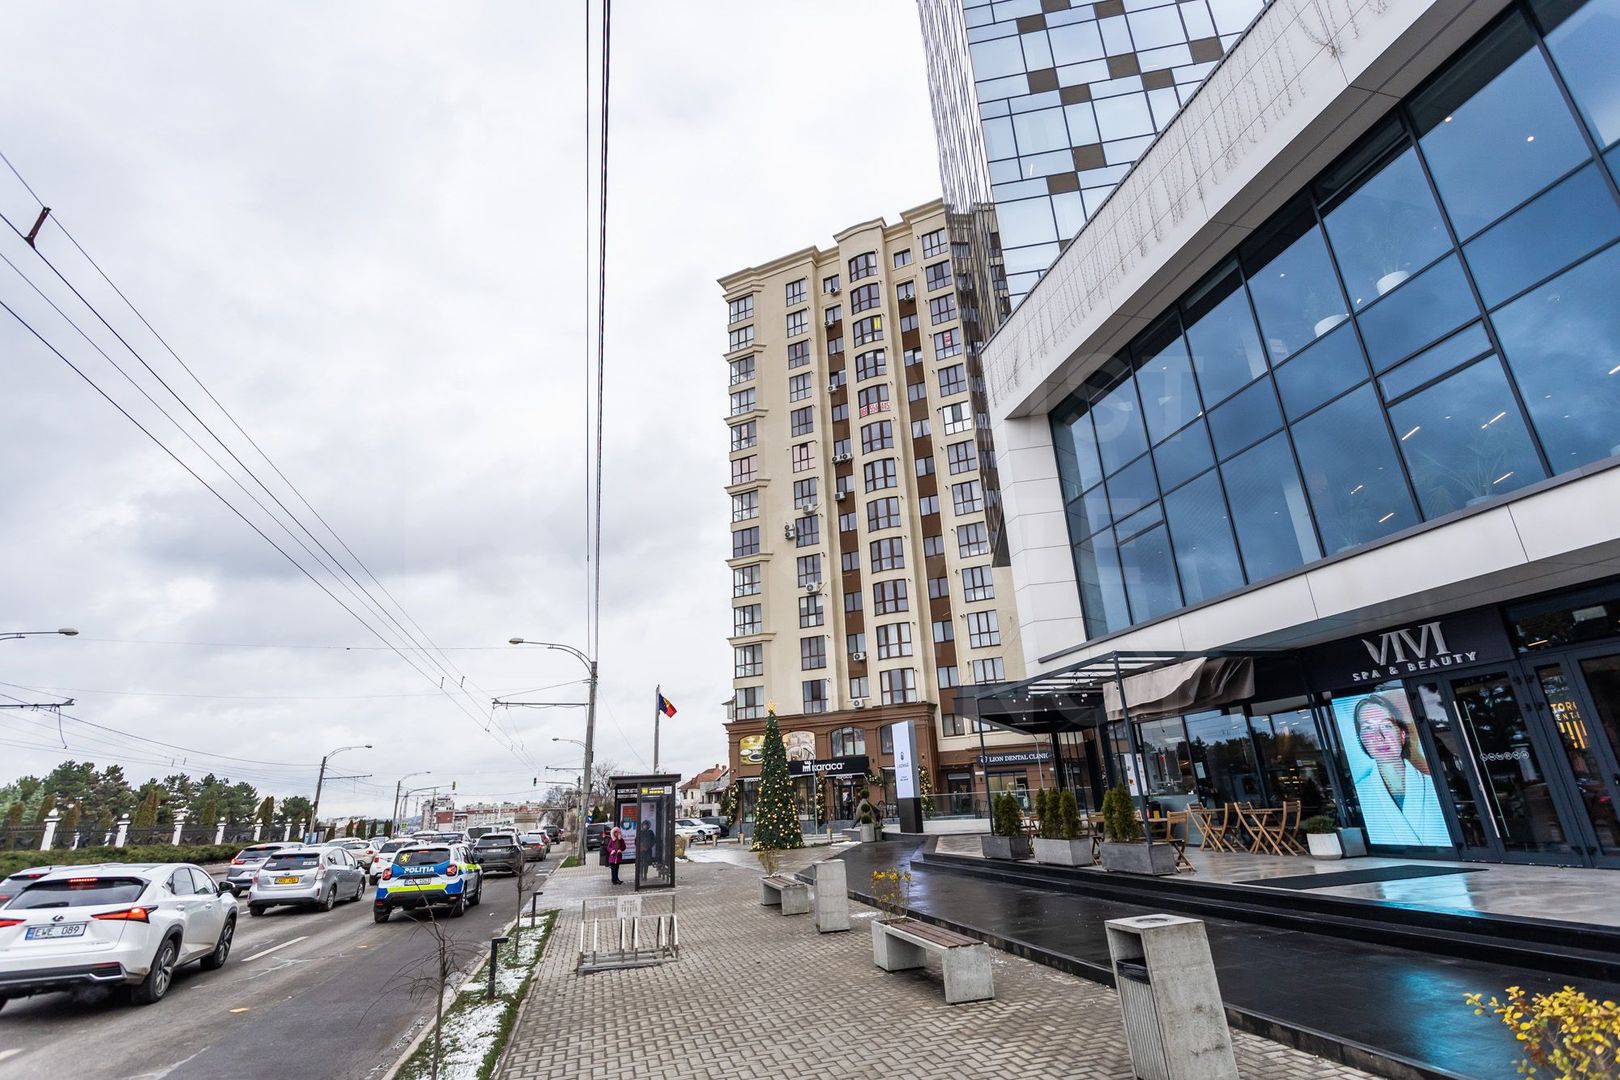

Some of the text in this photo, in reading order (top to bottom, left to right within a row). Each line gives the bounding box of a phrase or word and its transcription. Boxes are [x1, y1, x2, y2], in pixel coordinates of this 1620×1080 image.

[1361, 621, 1451, 666] VIVI
[1352, 651, 1477, 682] SPA & BEAUTY
[989, 755, 1004, 763] LION
[1004, 754, 1028, 762] DENTAL
[812, 762, 844, 772] karaca
[61, 925, 80, 935] 089
